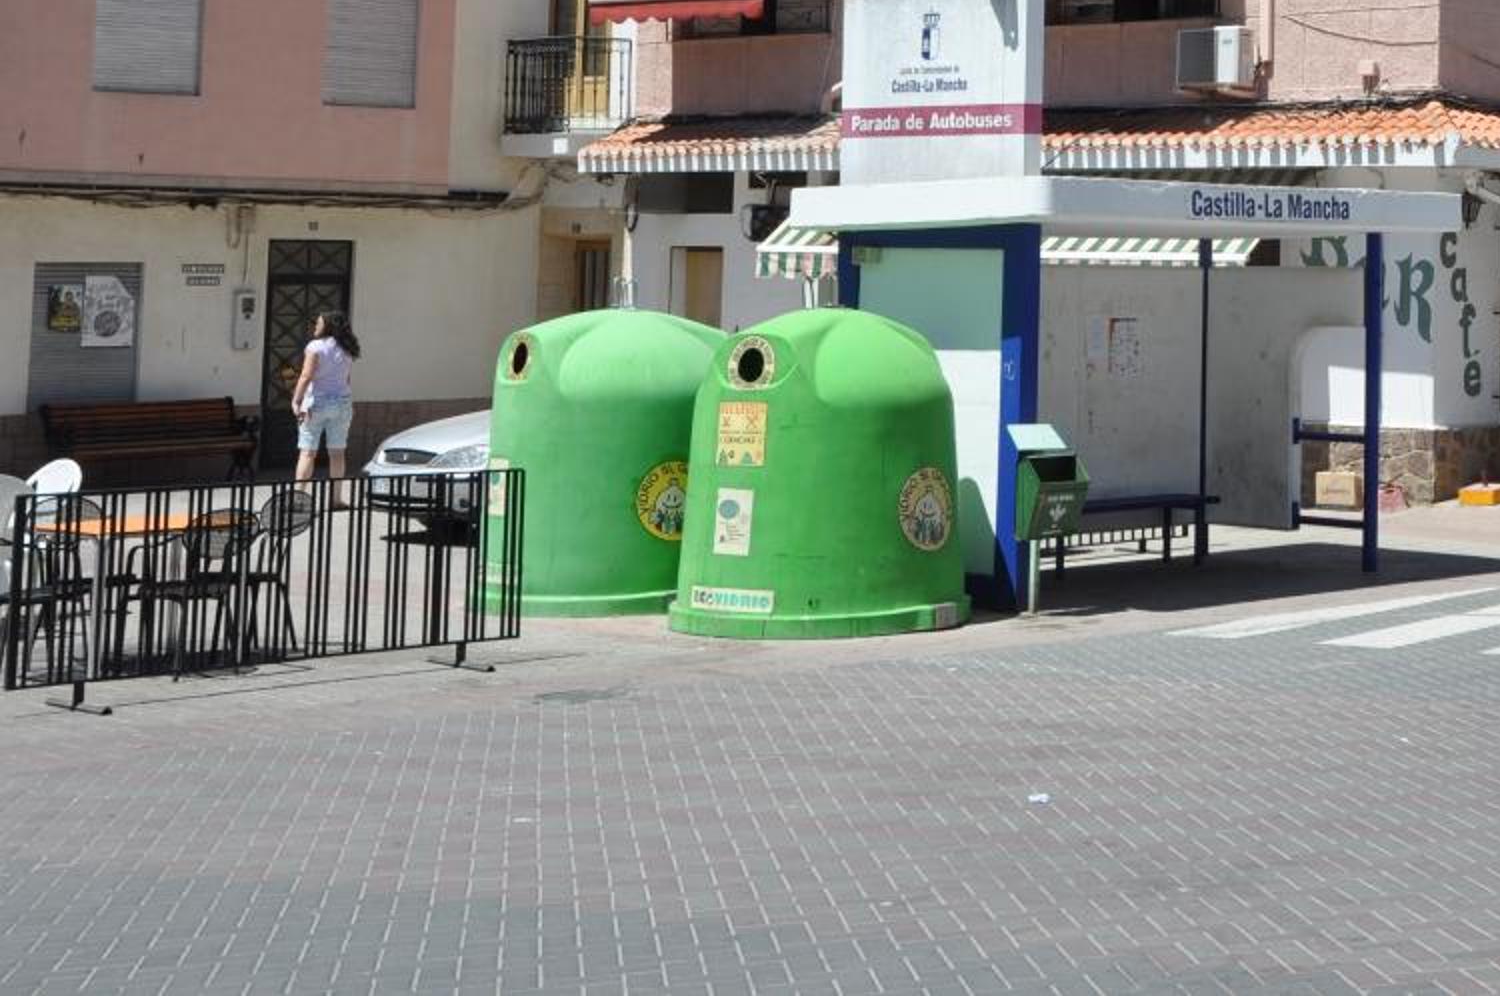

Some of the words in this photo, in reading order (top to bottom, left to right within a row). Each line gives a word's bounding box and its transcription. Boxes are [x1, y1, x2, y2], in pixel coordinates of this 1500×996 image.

[936, 77, 968, 91] Mancha
[851, 113, 900, 132] Parada
[905, 113, 925, 130] de
[929, 110, 1013, 130] Autobuses
[1191, 190, 1283, 218] Castilla-La
[1287, 193, 1350, 221] Mancha
